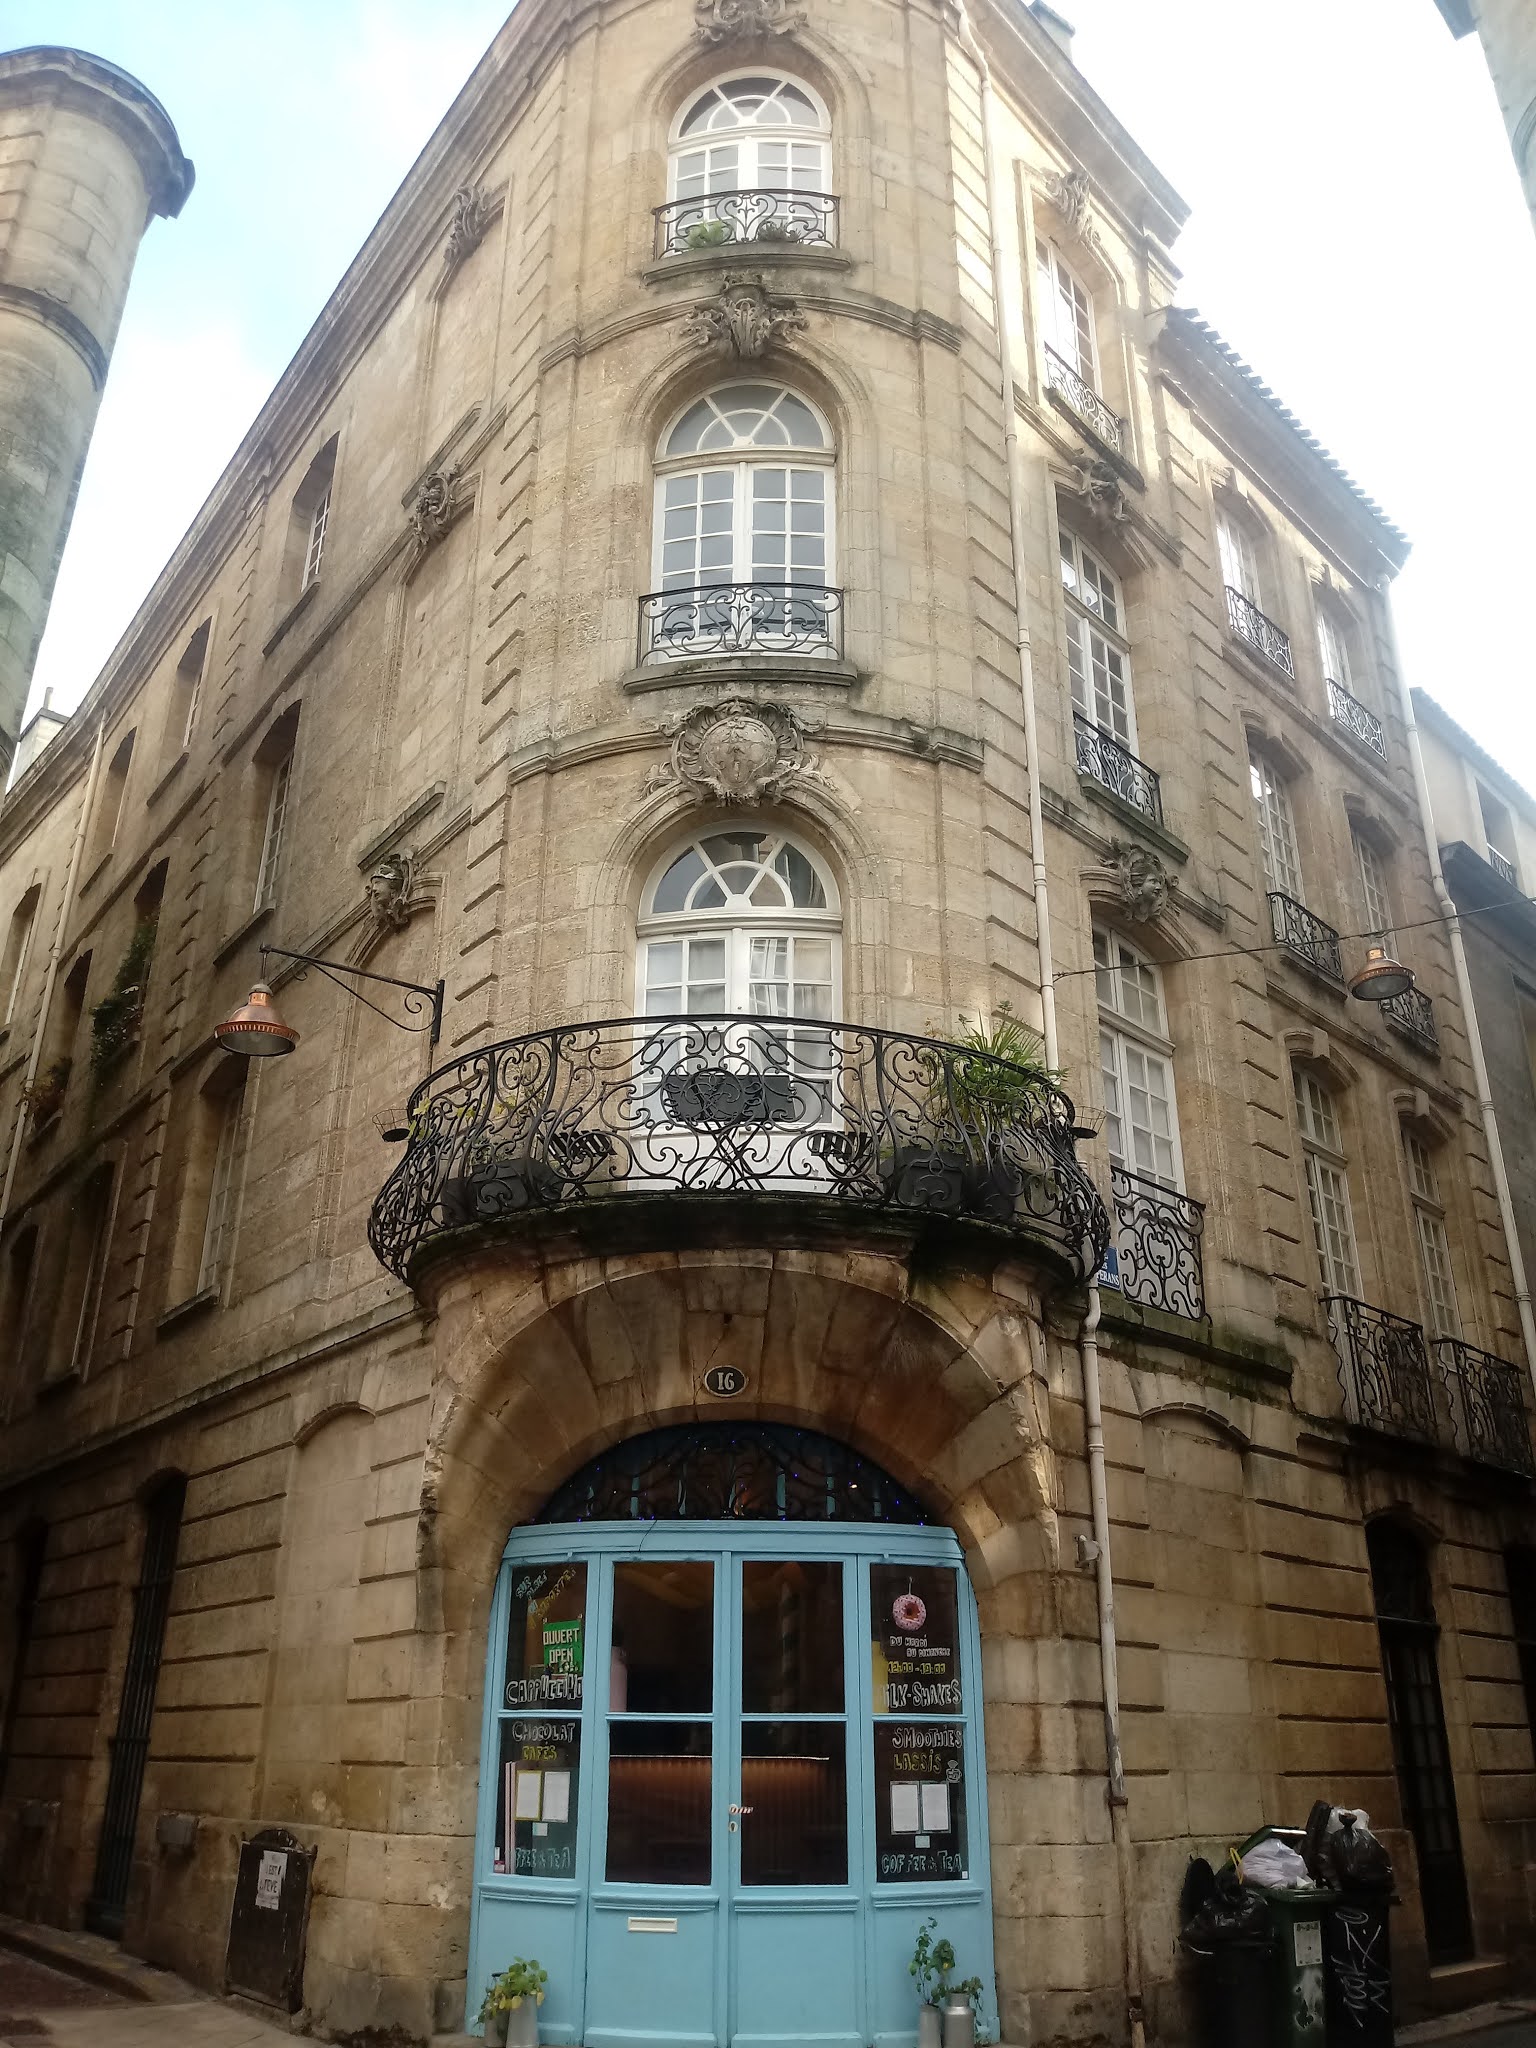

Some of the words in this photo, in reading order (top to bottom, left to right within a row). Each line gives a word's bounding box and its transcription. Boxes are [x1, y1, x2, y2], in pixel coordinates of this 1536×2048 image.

[717, 1372, 735, 1390] 16
[543, 1628, 580, 1646] OUVERT
[889, 1635, 903, 1647] DU
[549, 1647, 574, 1665] OPEN
[512, 1720, 576, 1744] CHOCOLAT
[937, 1849, 962, 1873] TEA
